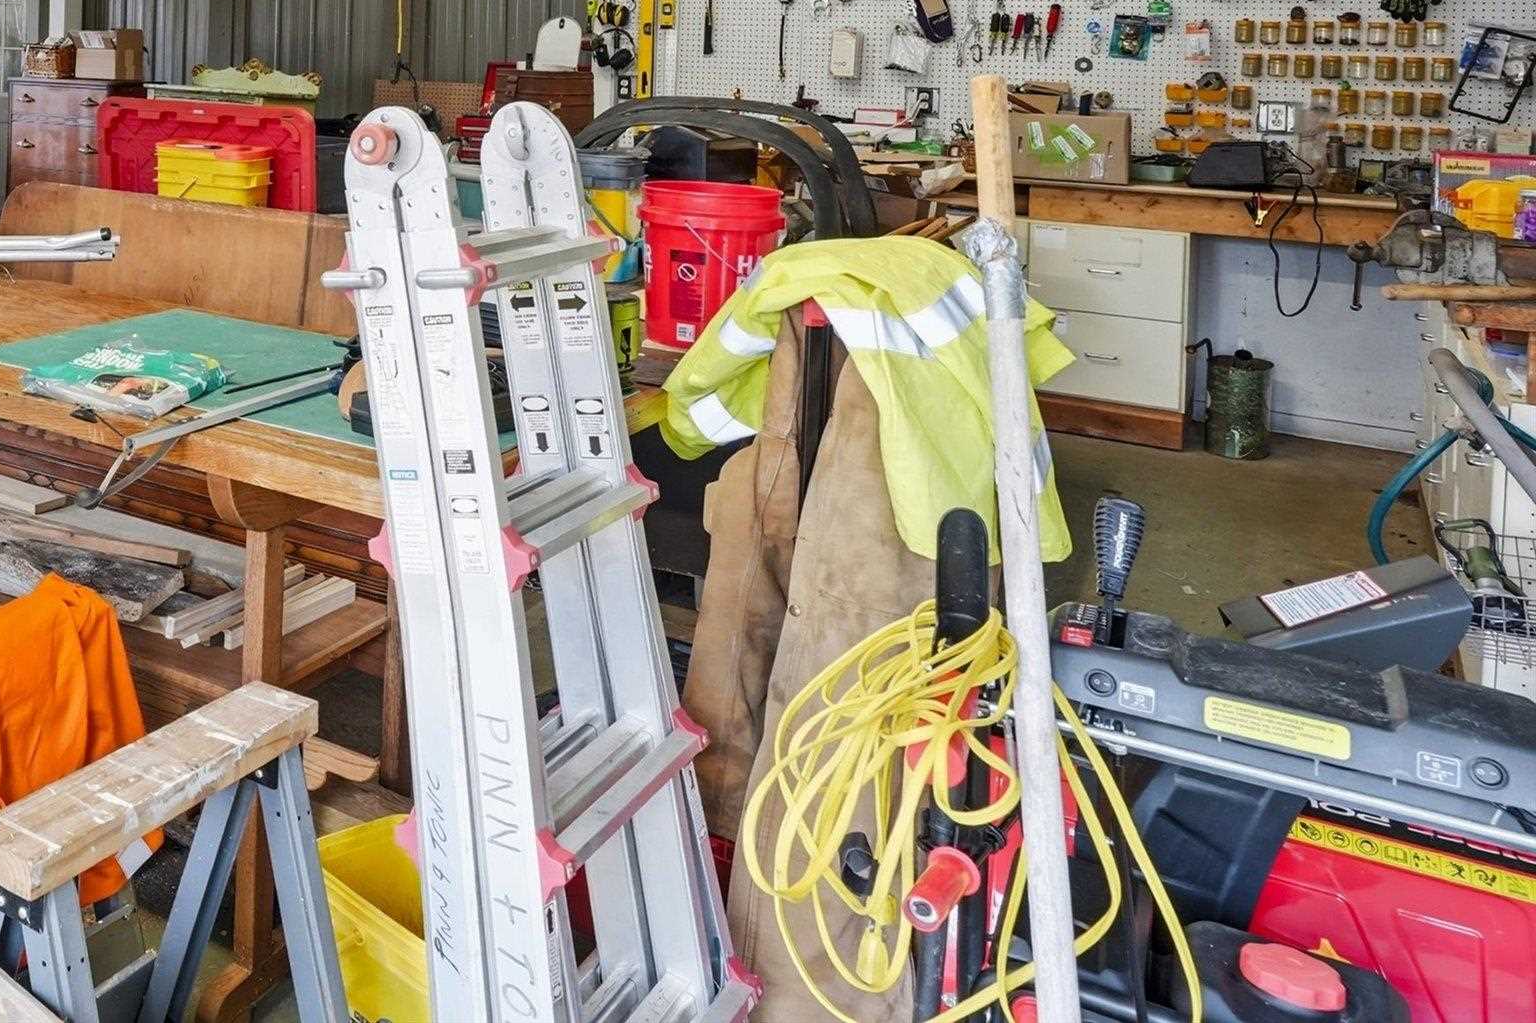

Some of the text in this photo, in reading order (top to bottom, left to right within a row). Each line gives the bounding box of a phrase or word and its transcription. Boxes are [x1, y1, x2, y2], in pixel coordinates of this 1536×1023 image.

[425, 768, 447, 854] TONIC
[476, 712, 521, 852] PINN
[431, 885, 461, 975] PINN
[498, 946, 537, 1023] TO
